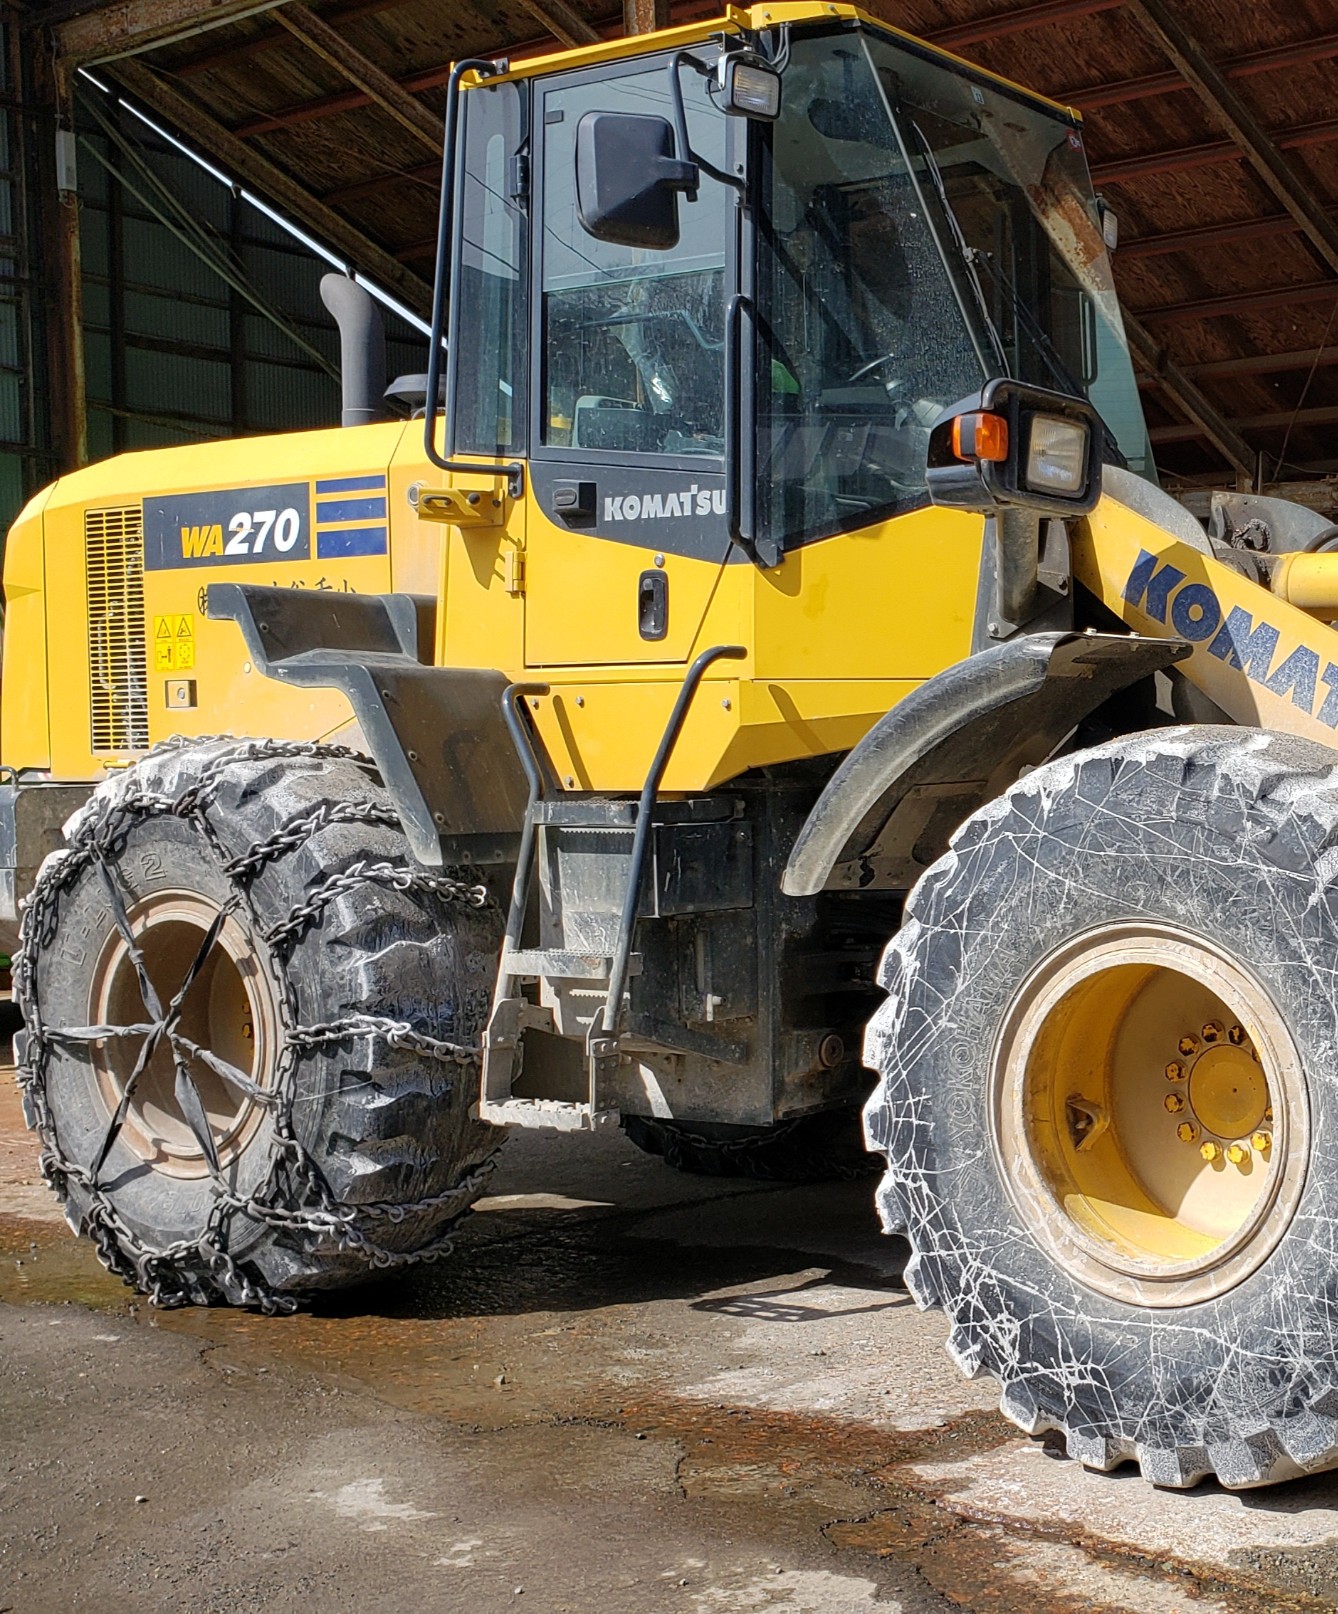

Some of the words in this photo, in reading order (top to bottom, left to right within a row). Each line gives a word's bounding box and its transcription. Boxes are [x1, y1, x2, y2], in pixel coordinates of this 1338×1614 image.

[604, 484, 726, 521] KOMATSU
[181, 508, 300, 559] WA270
[949, 948, 1021, 1142] YOKOHAMA
